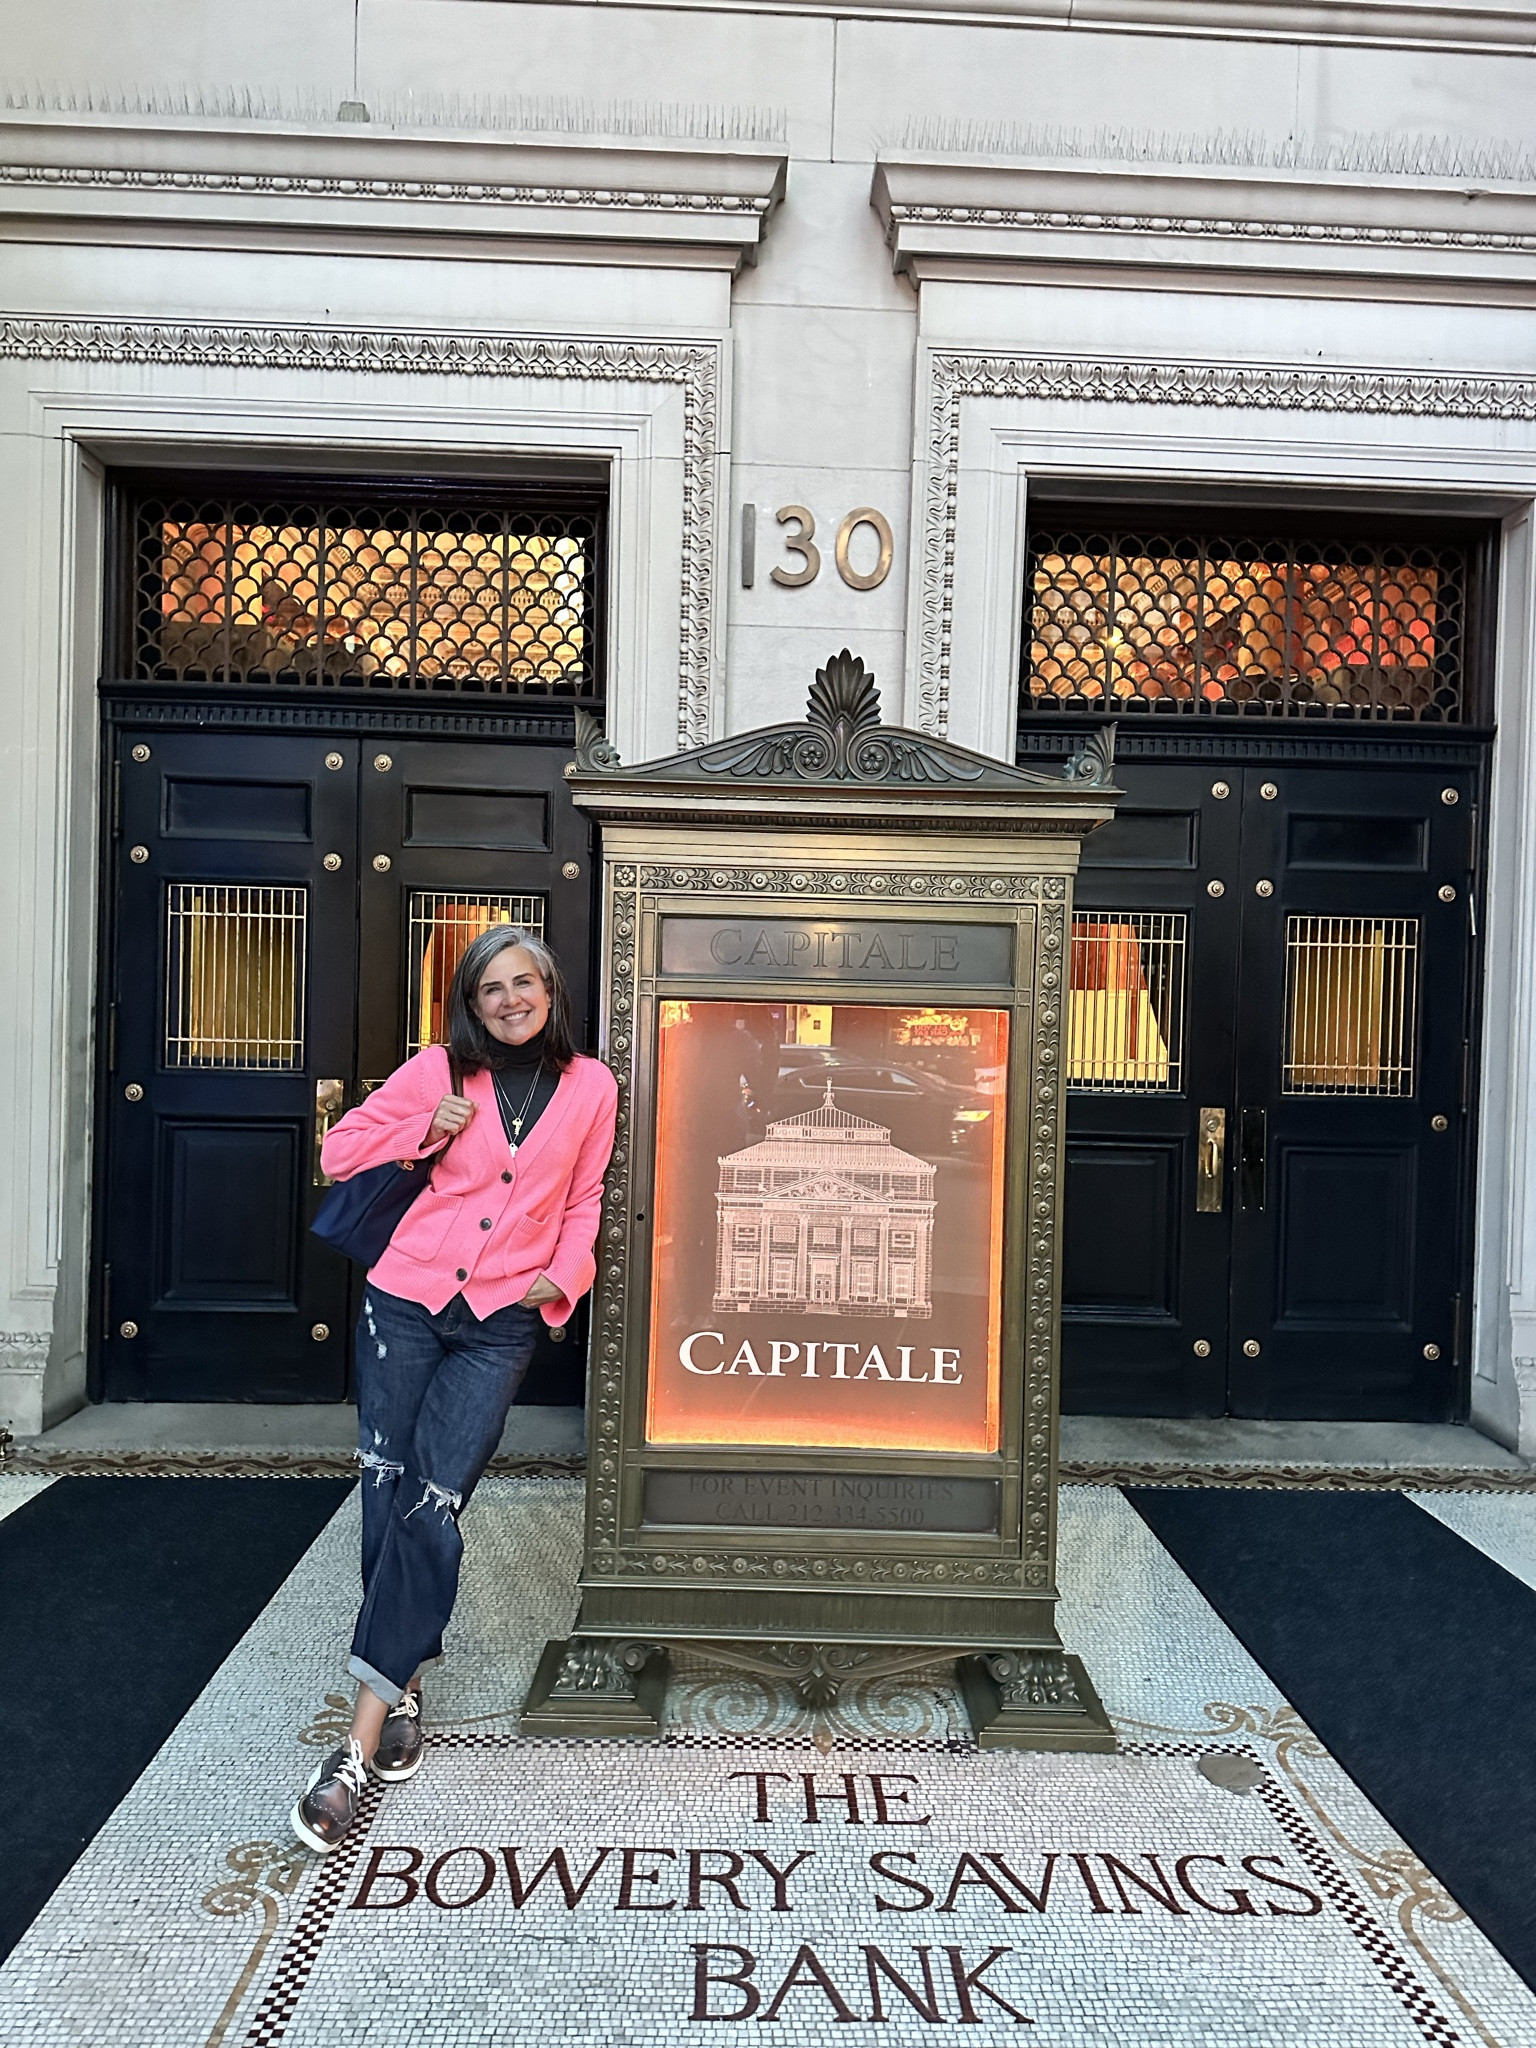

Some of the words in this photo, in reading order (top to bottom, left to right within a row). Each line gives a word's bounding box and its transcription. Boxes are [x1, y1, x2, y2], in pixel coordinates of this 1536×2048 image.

[741, 503, 894, 591] 130
[709, 928, 961, 972] CAPITALE
[678, 1331, 964, 1385] CAPITALE
[689, 1475, 735, 1495] FOR
[744, 1477, 824, 1498] EVENT
[831, 1479, 954, 1502] INQUIRIES
[716, 1502, 780, 1522] CALL
[787, 1504, 925, 1526] 212.334.5500
[727, 1771, 933, 1826] THE
[347, 1845, 817, 1911] BOWERY
[873, 1849, 1325, 1918] SAVINGS
[687, 1942, 1036, 2025] BANK
